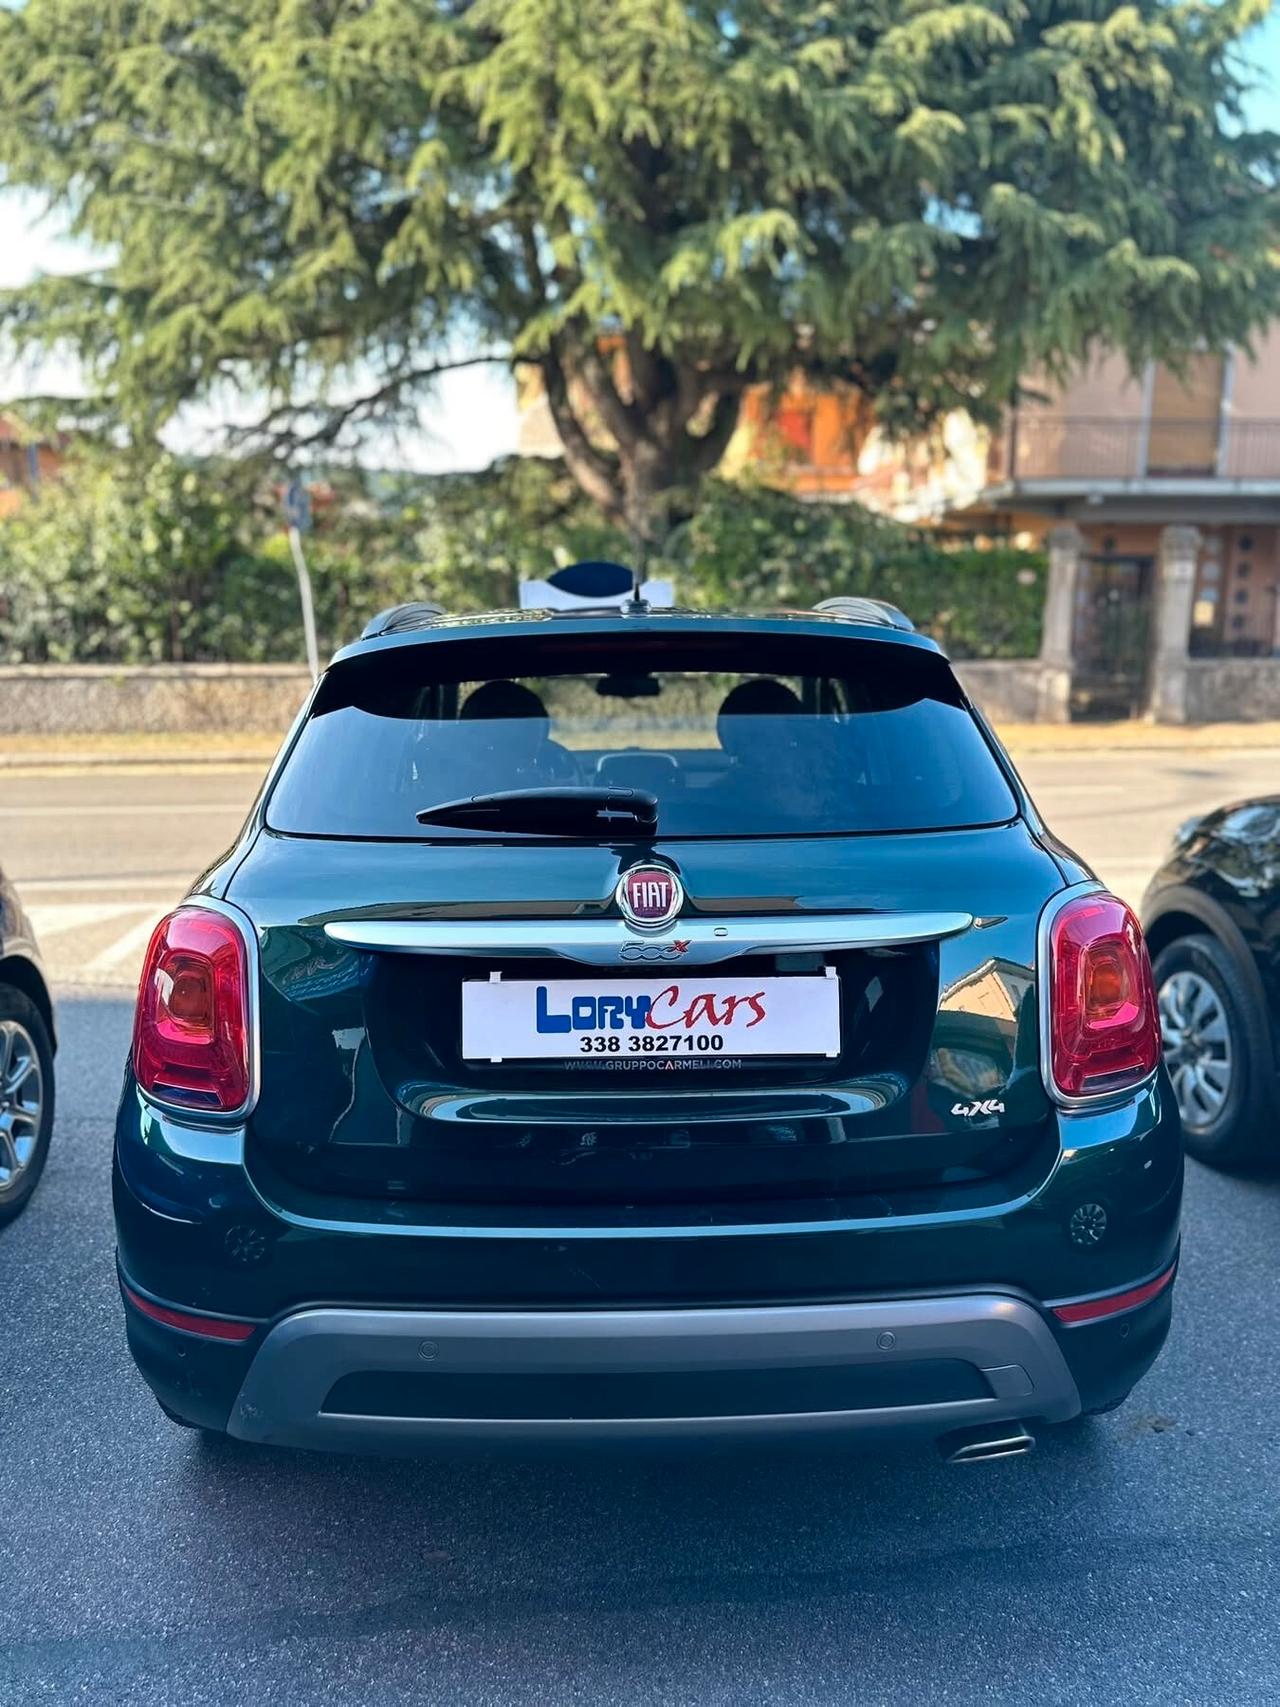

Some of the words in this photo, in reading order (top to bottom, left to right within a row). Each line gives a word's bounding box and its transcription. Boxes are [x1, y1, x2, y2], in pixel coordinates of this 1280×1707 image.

[632, 881, 669, 908] FIAT
[579, 1036, 621, 1053] 338
[628, 1034, 724, 1052] 3827100
